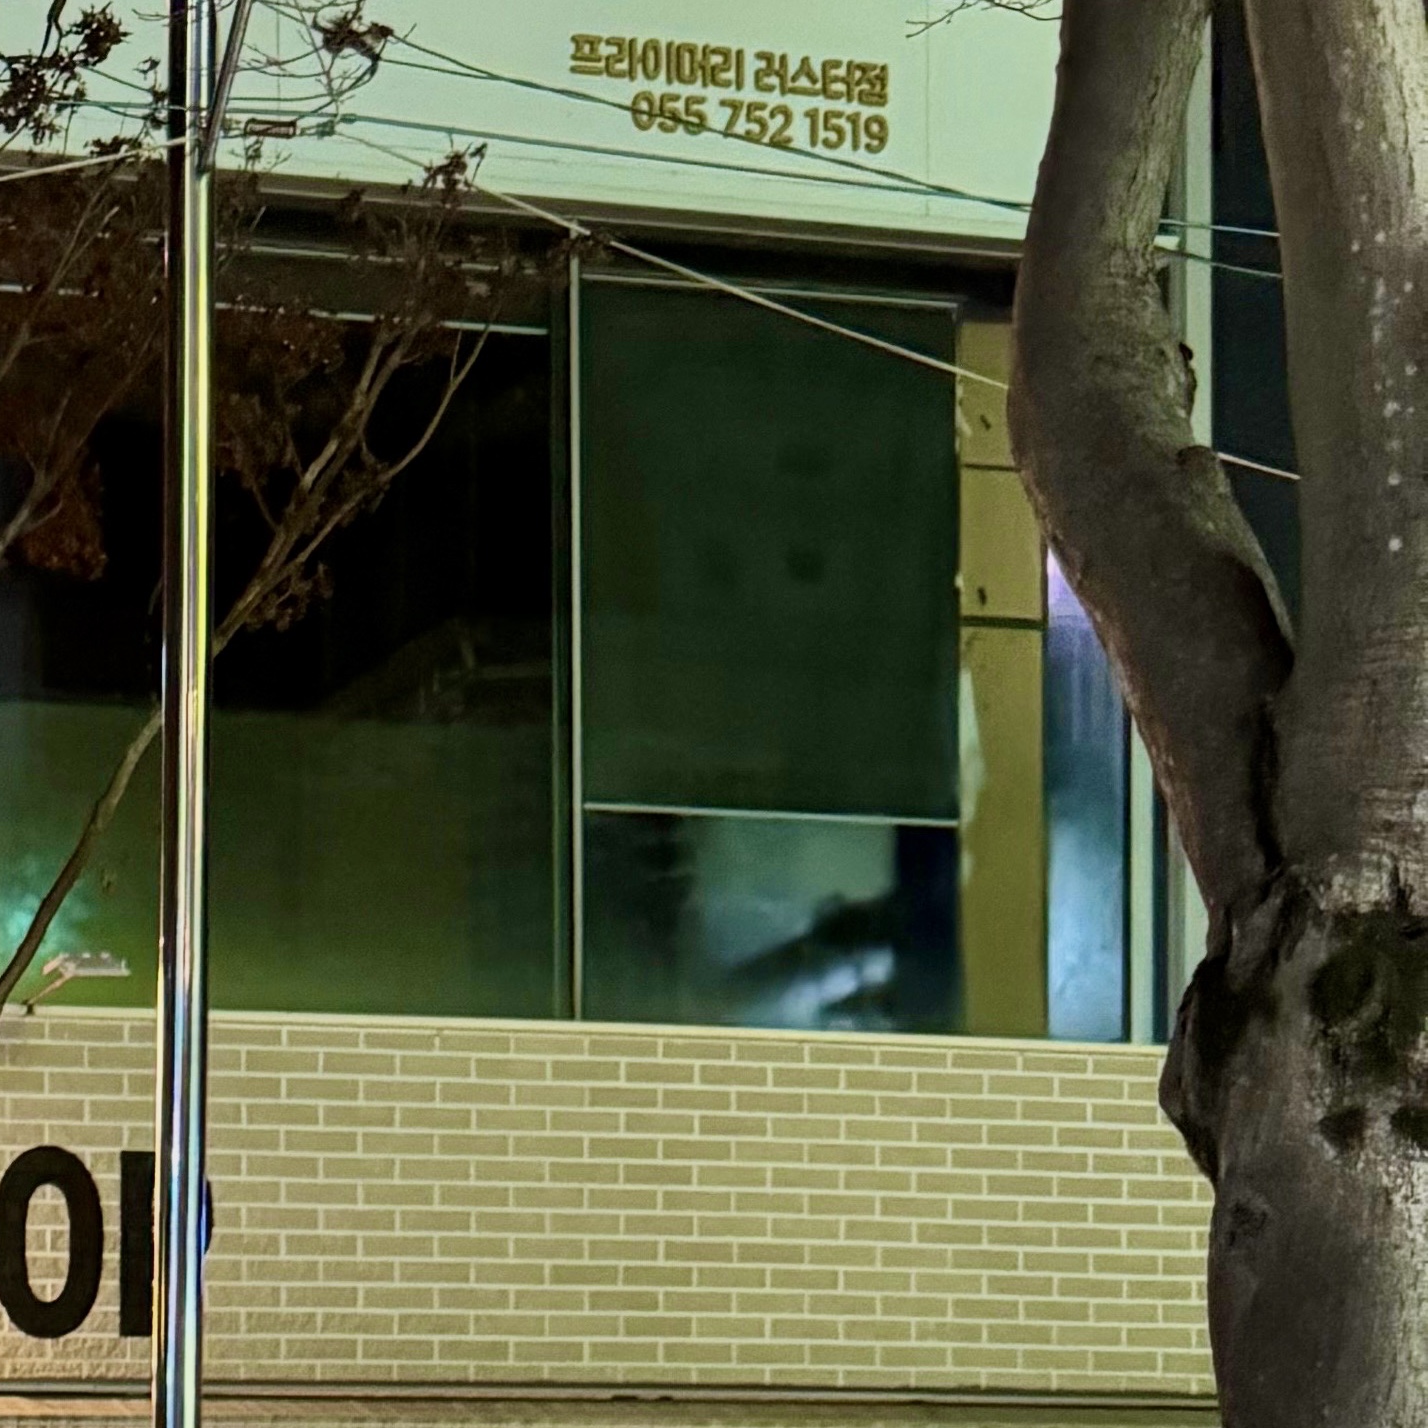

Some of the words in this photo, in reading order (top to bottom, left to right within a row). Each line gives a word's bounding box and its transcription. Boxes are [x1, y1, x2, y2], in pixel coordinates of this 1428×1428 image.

[570, 34, 745, 91] 프라이머리
[754, 51, 888, 107] 러스터점
[631, 91, 707, 134] 055
[720, 99, 794, 146] 752
[805, 109, 888, 154] 1519
